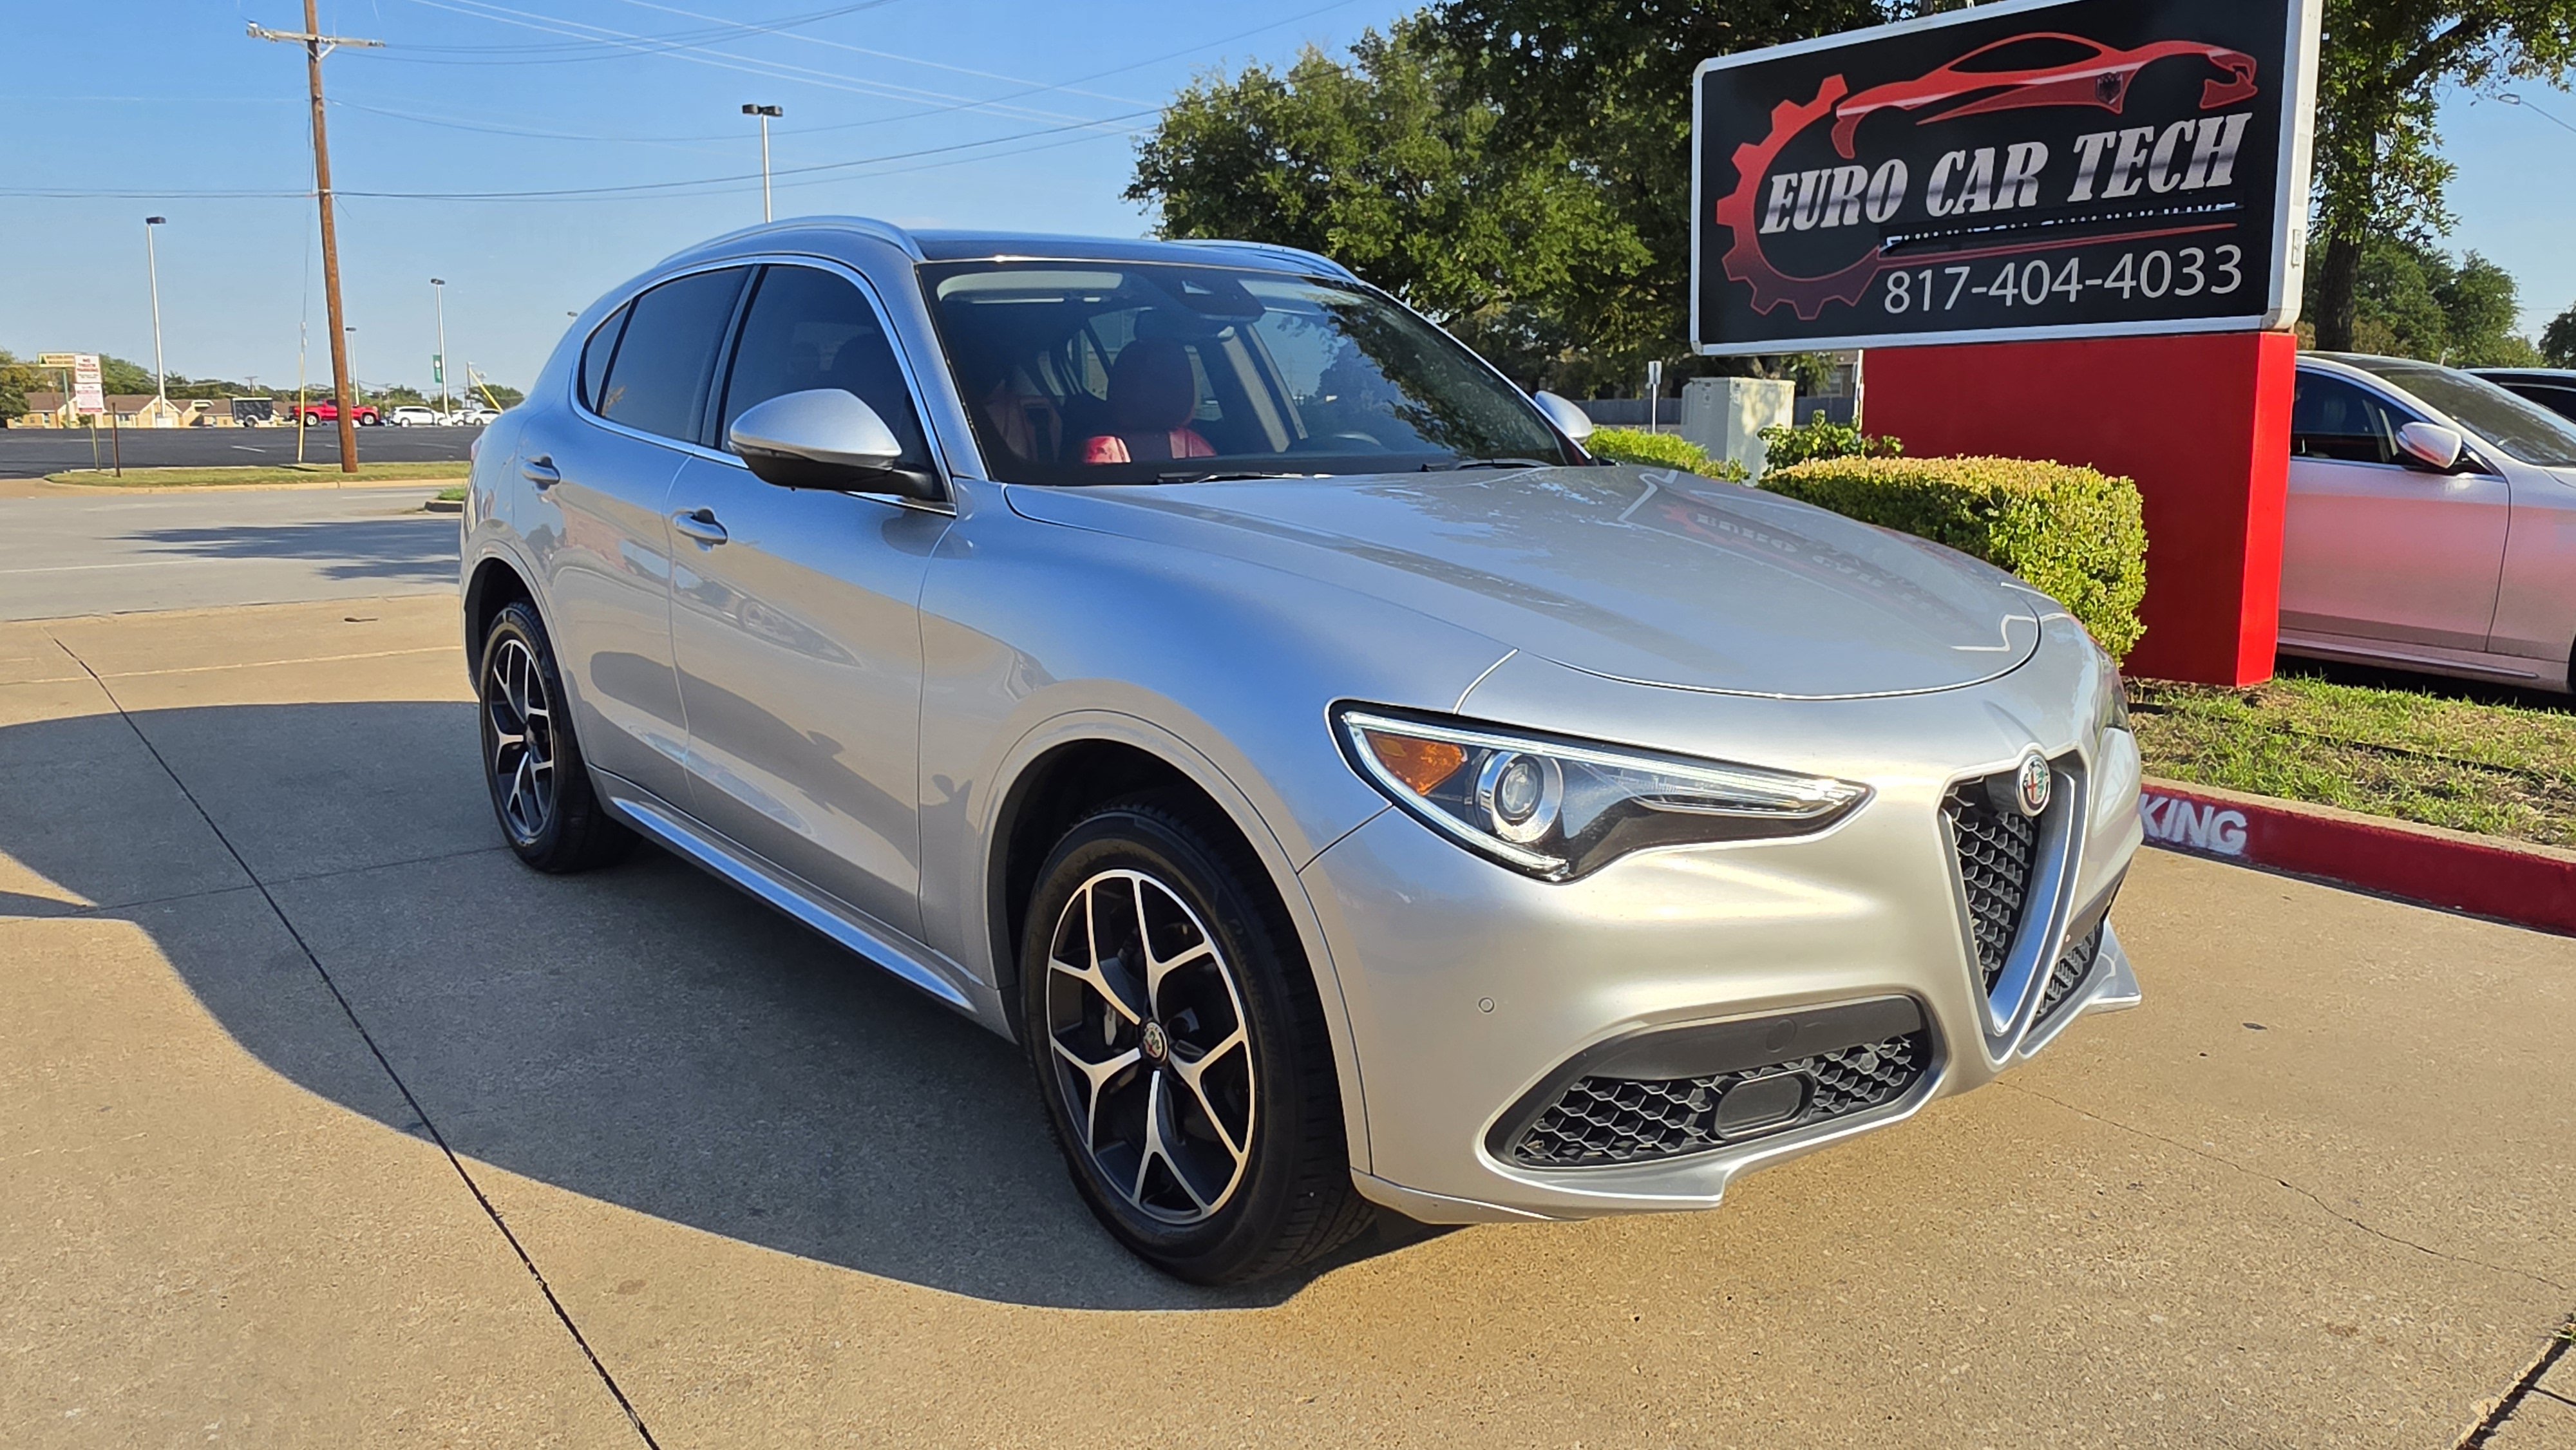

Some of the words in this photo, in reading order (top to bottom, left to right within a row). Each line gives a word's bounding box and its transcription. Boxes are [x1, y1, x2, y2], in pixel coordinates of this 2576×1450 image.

[1759, 159, 1909, 234] EURO
[1926, 141, 2049, 217] CAR
[2067, 113, 2253, 202] TECH
[1884, 245, 2242, 314] 817-404-4033
